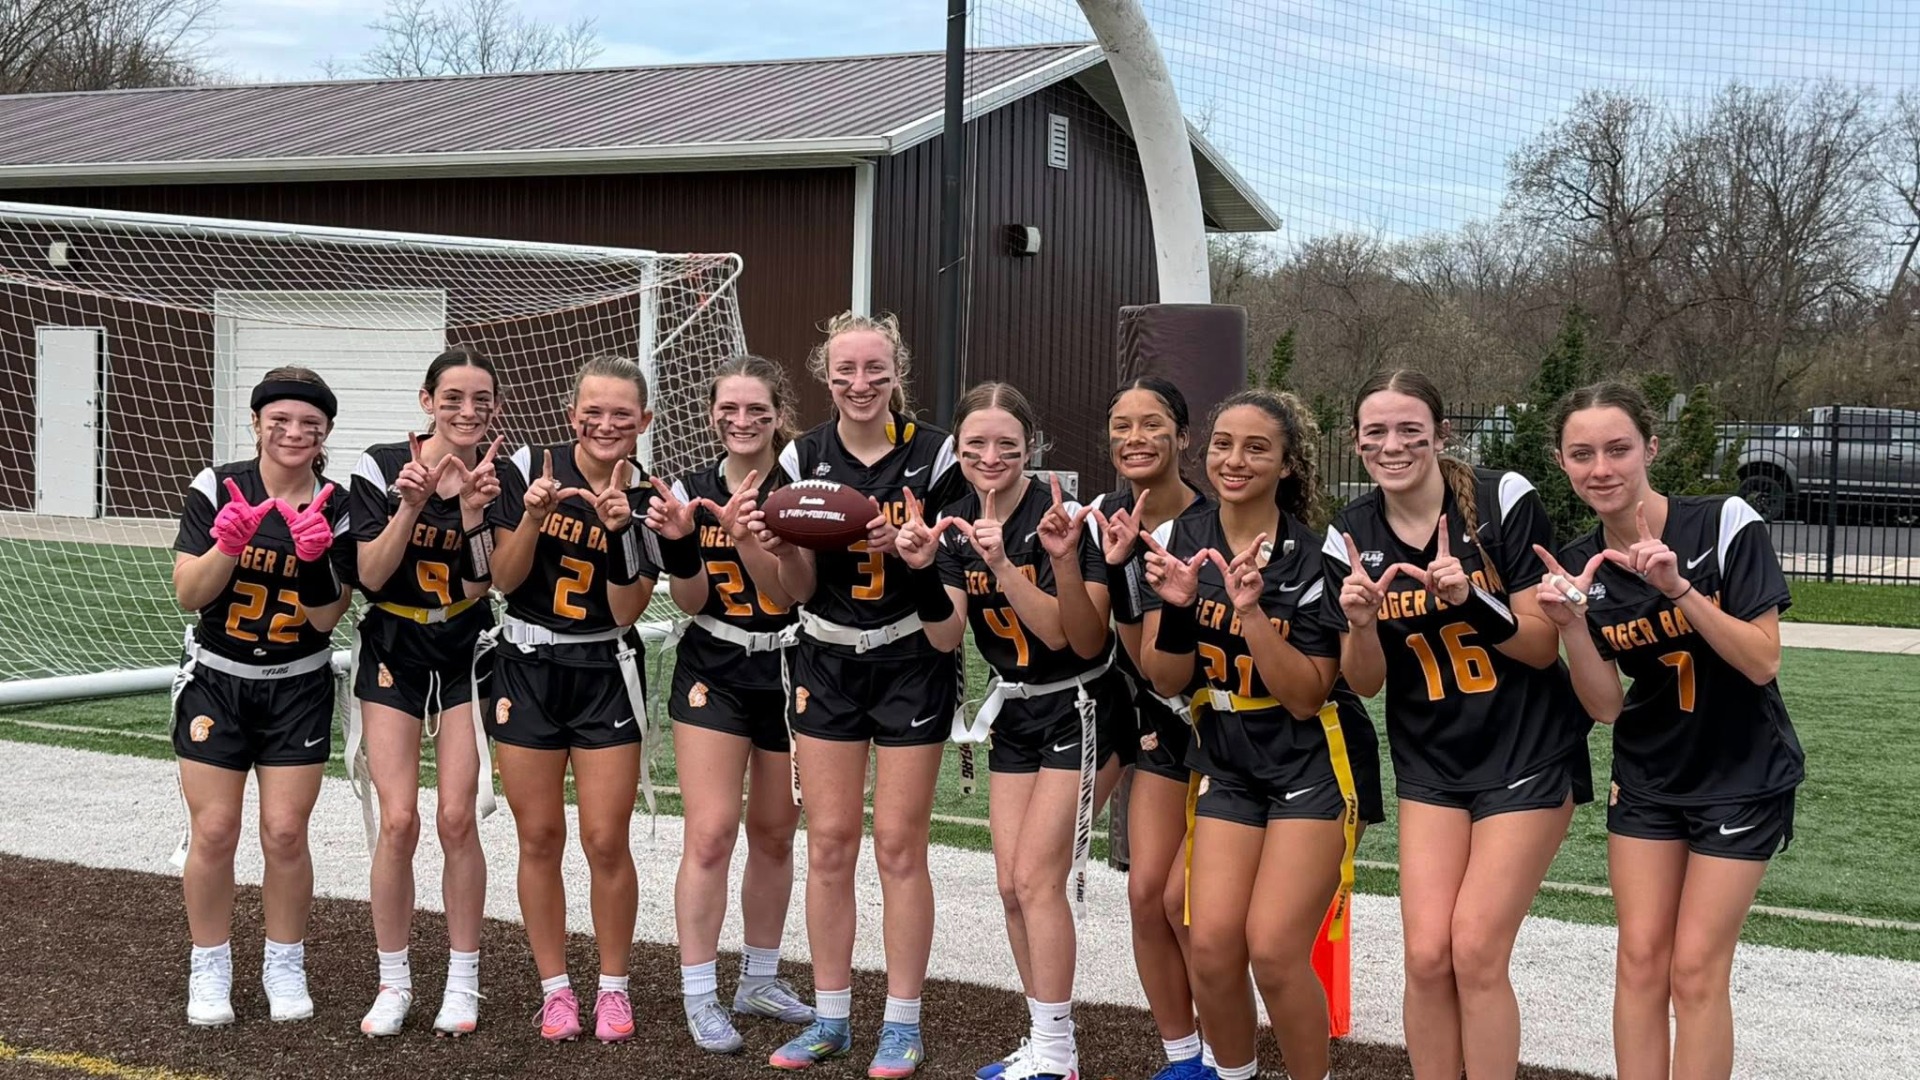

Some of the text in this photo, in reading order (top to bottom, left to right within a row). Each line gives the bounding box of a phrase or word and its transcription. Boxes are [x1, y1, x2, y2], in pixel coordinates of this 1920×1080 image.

[848, 540, 885, 600] 3
[1360, 550, 1385, 563] FLAG
[416, 560, 452, 606] 9
[553, 555, 595, 620] 2
[1588, 583, 1606, 595] LAG
[225, 580, 307, 643] 22
[1377, 589, 1428, 621] OGER
[982, 606, 1029, 667] 4
[1601, 617, 1659, 651] OGER
[266, 665, 290, 677] FLAG
[1405, 621, 1498, 701] 16
[1657, 650, 1696, 713] 7
[959, 746, 974, 780] FLAG
[1076, 877, 1085, 903] FLAG
